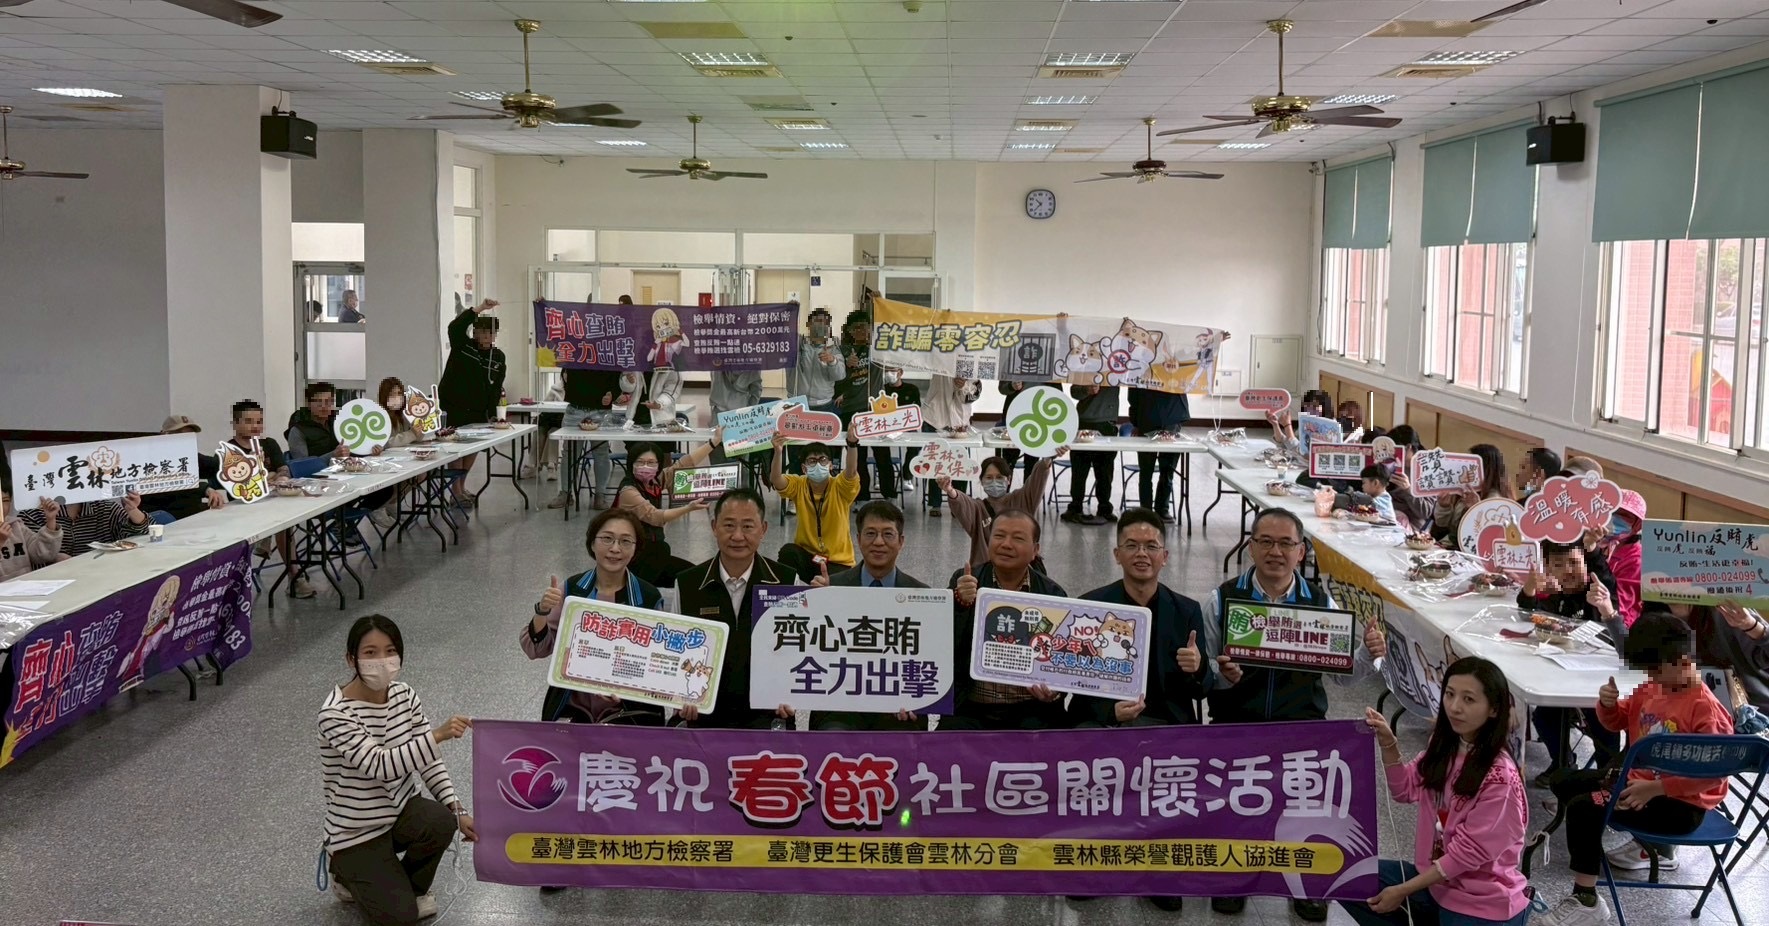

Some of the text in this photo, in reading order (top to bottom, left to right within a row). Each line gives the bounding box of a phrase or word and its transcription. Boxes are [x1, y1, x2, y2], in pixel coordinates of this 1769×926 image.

[544, 307, 625, 340] 齊心查賄
[747, 311, 790, 324] 絕對保密
[742, 341, 790, 353] 05-6329183
[874, 319, 1022, 353] 詐騙零容忍
[556, 337, 636, 368] 全力出擊
[859, 410, 918, 433] 雲林之光
[923, 442, 955, 462] 雲林
[24, 456, 189, 491] 臺灣雲林地方檢察署
[1528, 490, 1613, 525] 溫暖有感
[1497, 546, 1536, 567] 雲林之光
[1695, 571, 1756, 583] 0800-024099
[581, 611, 706, 654] 防詐實用小撇步
[996, 613, 1016, 633] 詐
[1230, 609, 1250, 633] 賄
[1251, 613, 1302, 629] 檢舉賄選
[773, 614, 921, 656] 齊心查賄
[1266, 628, 1329, 646] 逗陣LINE
[1050, 650, 1134, 675] 不要以為沒事
[790, 656, 939, 698] 全力出擊
[531, 837, 1315, 869] 臺灣雲林地方檢察署 臺灣更生保護會雲林分會 雲林縣榮譽觀護人協進會
